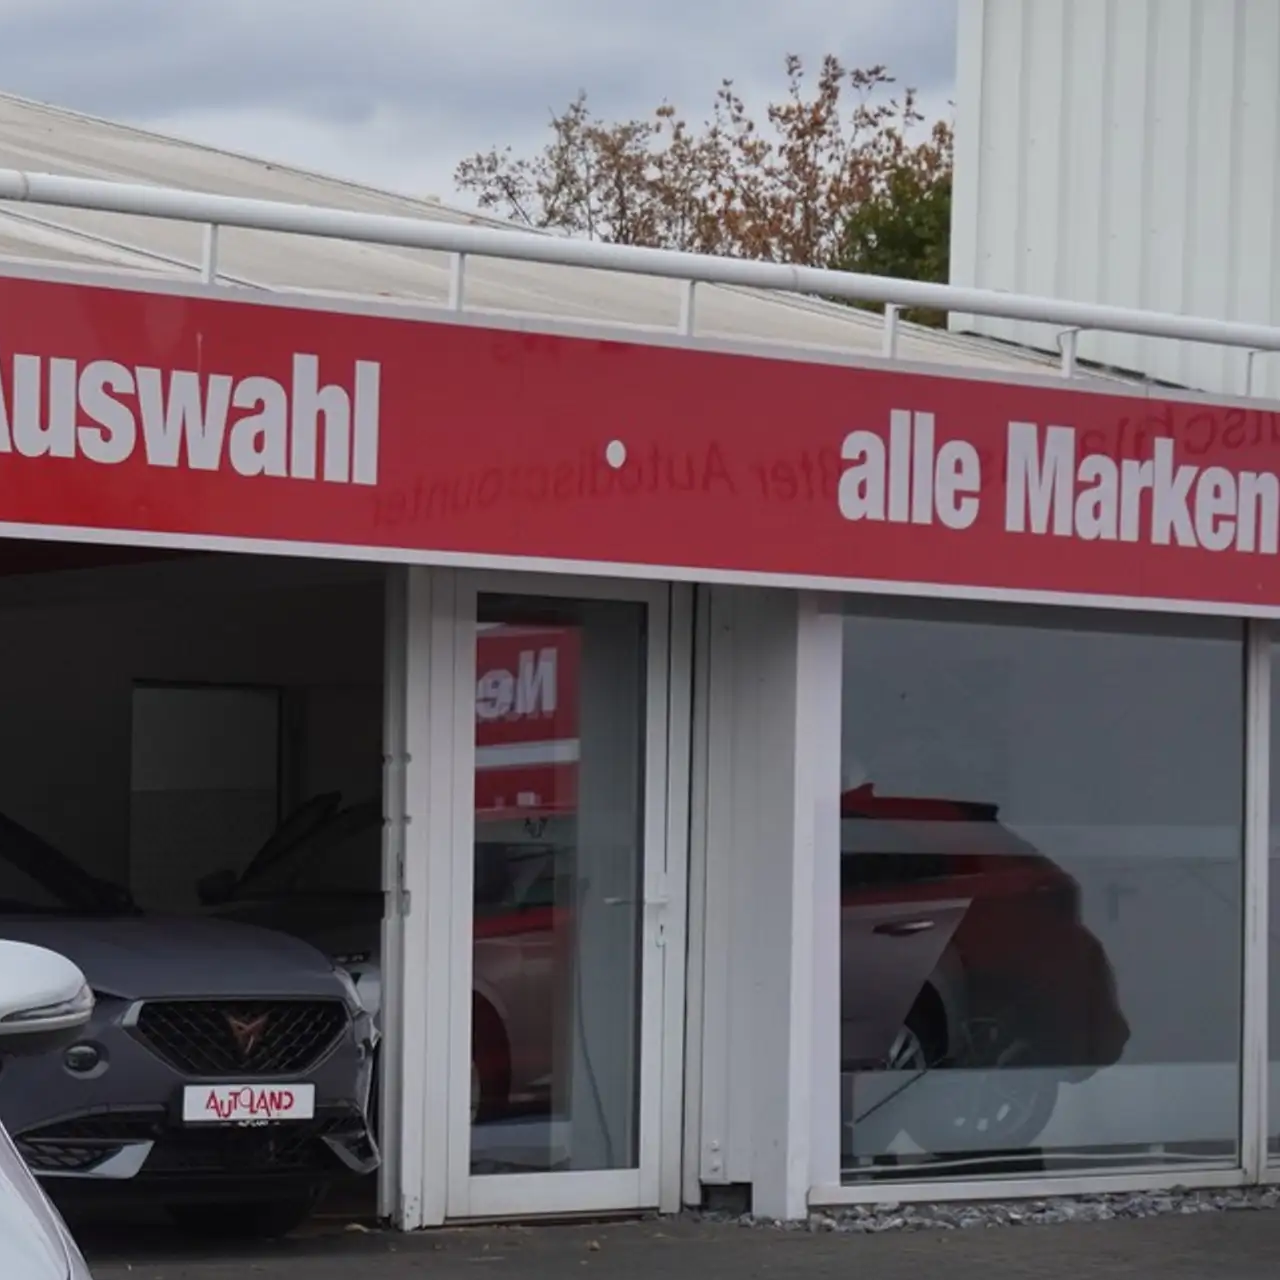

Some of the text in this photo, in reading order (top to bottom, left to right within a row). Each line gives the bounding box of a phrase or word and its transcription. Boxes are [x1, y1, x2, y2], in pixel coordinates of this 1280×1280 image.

[838, 408, 1279, 555] alle Marken
[205, 1086, 295, 1118] AUTOLAND
